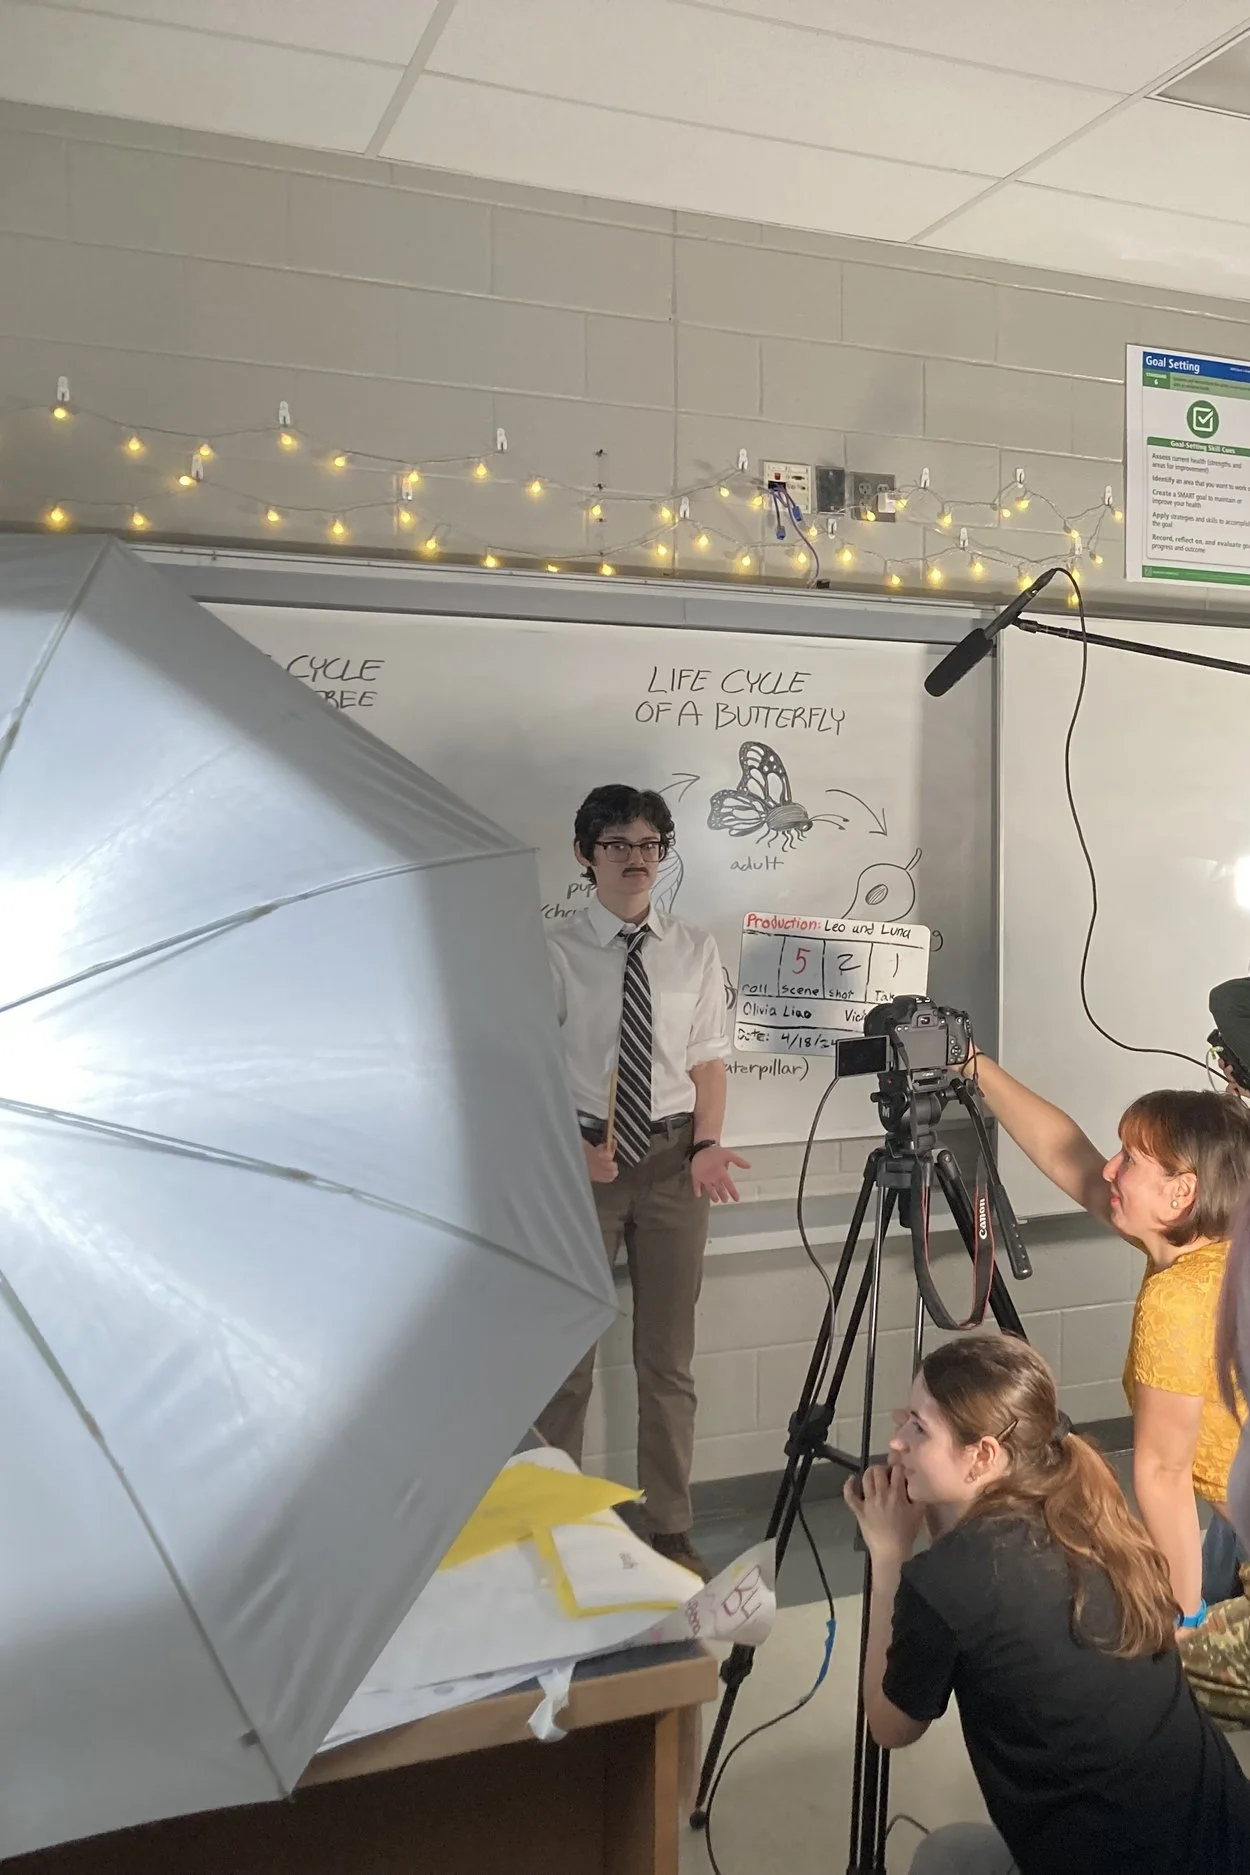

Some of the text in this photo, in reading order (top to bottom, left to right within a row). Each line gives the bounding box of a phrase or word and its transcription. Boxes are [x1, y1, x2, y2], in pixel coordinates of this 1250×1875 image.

[1145, 356, 1200, 374] Goal Setting
[1170, 440, 1208, 452] Goal-Setting
[1208, 444, 1221, 453] Skill
[1152, 453, 1171, 461] Assess
[1191, 456, 1207, 465] health
[1152, 475, 1175, 485] Identify
[1152, 488, 1171, 497] Create
[1177, 491, 1195, 499] SMART
[1196, 493, 1207, 501] goal
[1173, 500, 1184, 508] your
[1186, 500, 1201, 509] health
[1152, 511, 1169, 520] Apply
[1161, 521, 1173, 529] goal
[1151, 533, 1174, 543] Record,
[1175, 535, 1194, 544] reflect
[286, 654, 386, 683] CYCLE
[647, 665, 812, 695] LIFE CYCLE
[635, 700, 846, 736] OF A BUTTERFLY
[730, 855, 785, 872] adult
[566, 882, 598, 900] pup
[747, 914, 822, 931] Production:
[824, 920, 846, 933] Leo
[880, 925, 912, 939] Luna
[792, 948, 811, 975] 5
[836, 953, 861, 972] 2
[741, 984, 895, 1002] roll scene shot Tak
[742, 1004, 777, 1017] Olivia
[782, 1006, 812, 1019] Liao
[724, 1056, 810, 1082] aterpillar)
[979, 1198, 987, 1240] Canon
